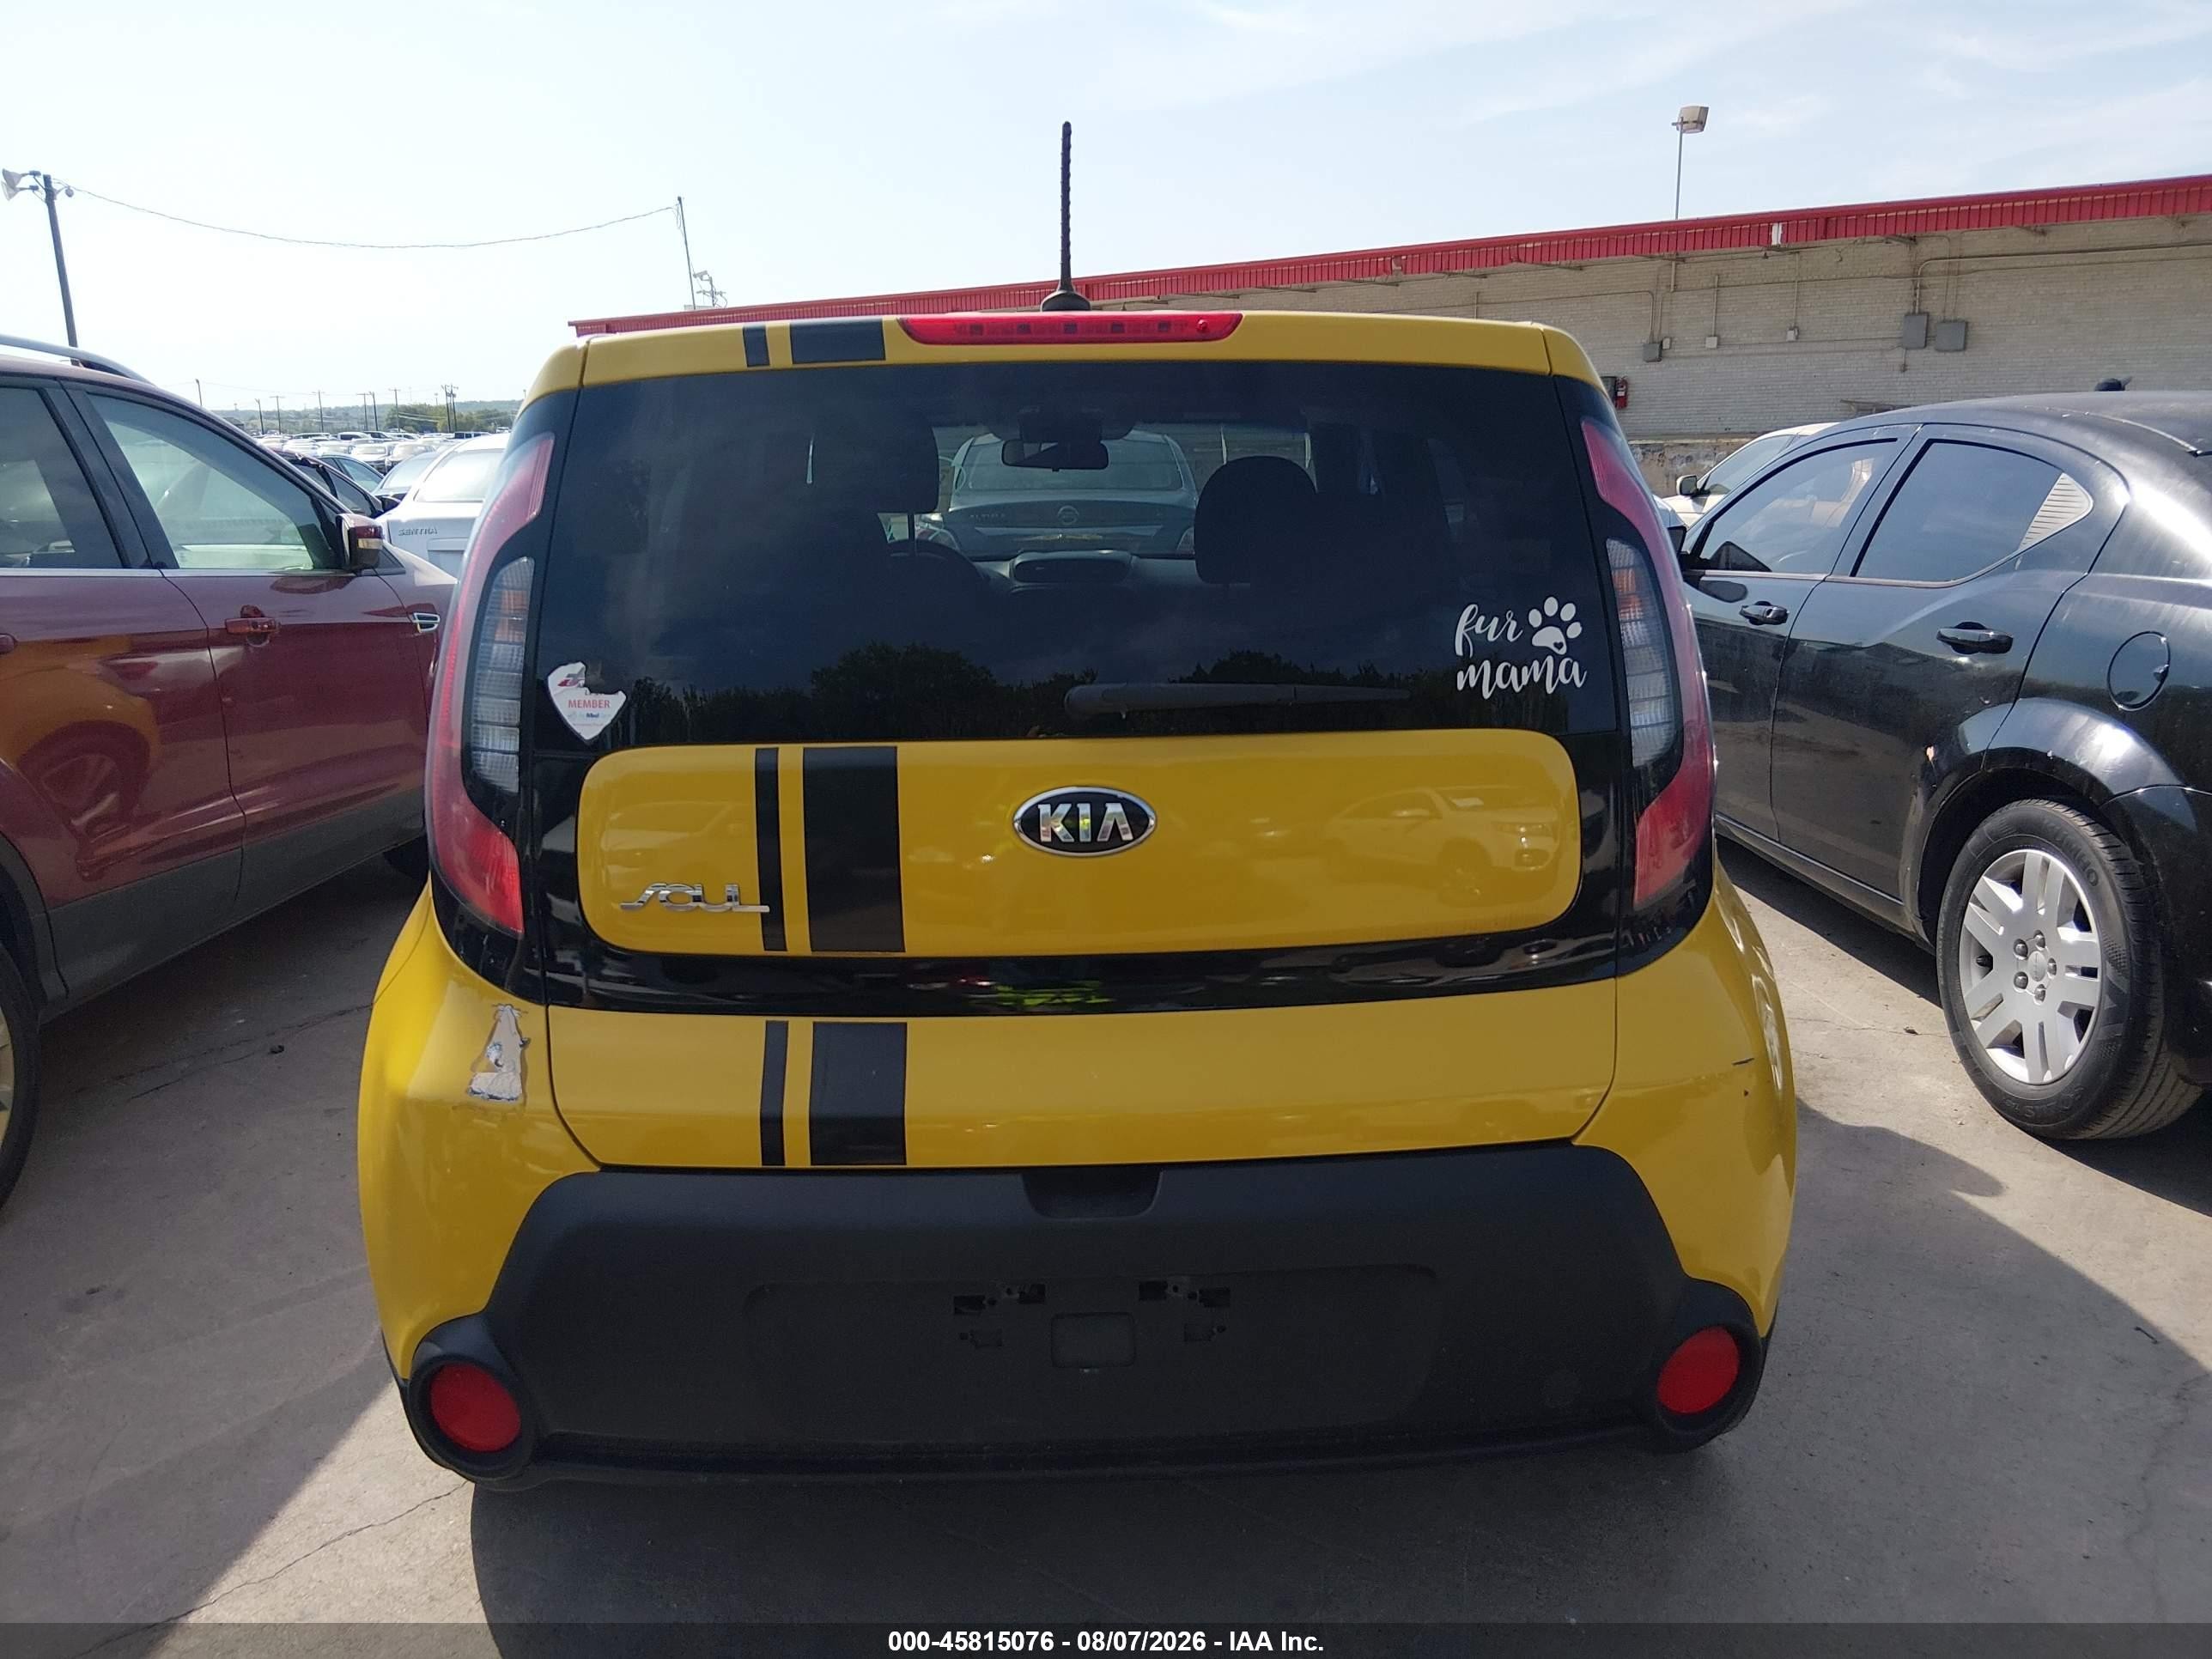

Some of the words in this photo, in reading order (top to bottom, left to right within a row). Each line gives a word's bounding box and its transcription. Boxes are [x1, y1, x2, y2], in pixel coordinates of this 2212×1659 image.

[1455, 604, 1523, 658] fur
[1457, 655, 1587, 700] mama
[568, 699, 611, 708] MEMBER
[1037, 802, 1134, 842] KIA
